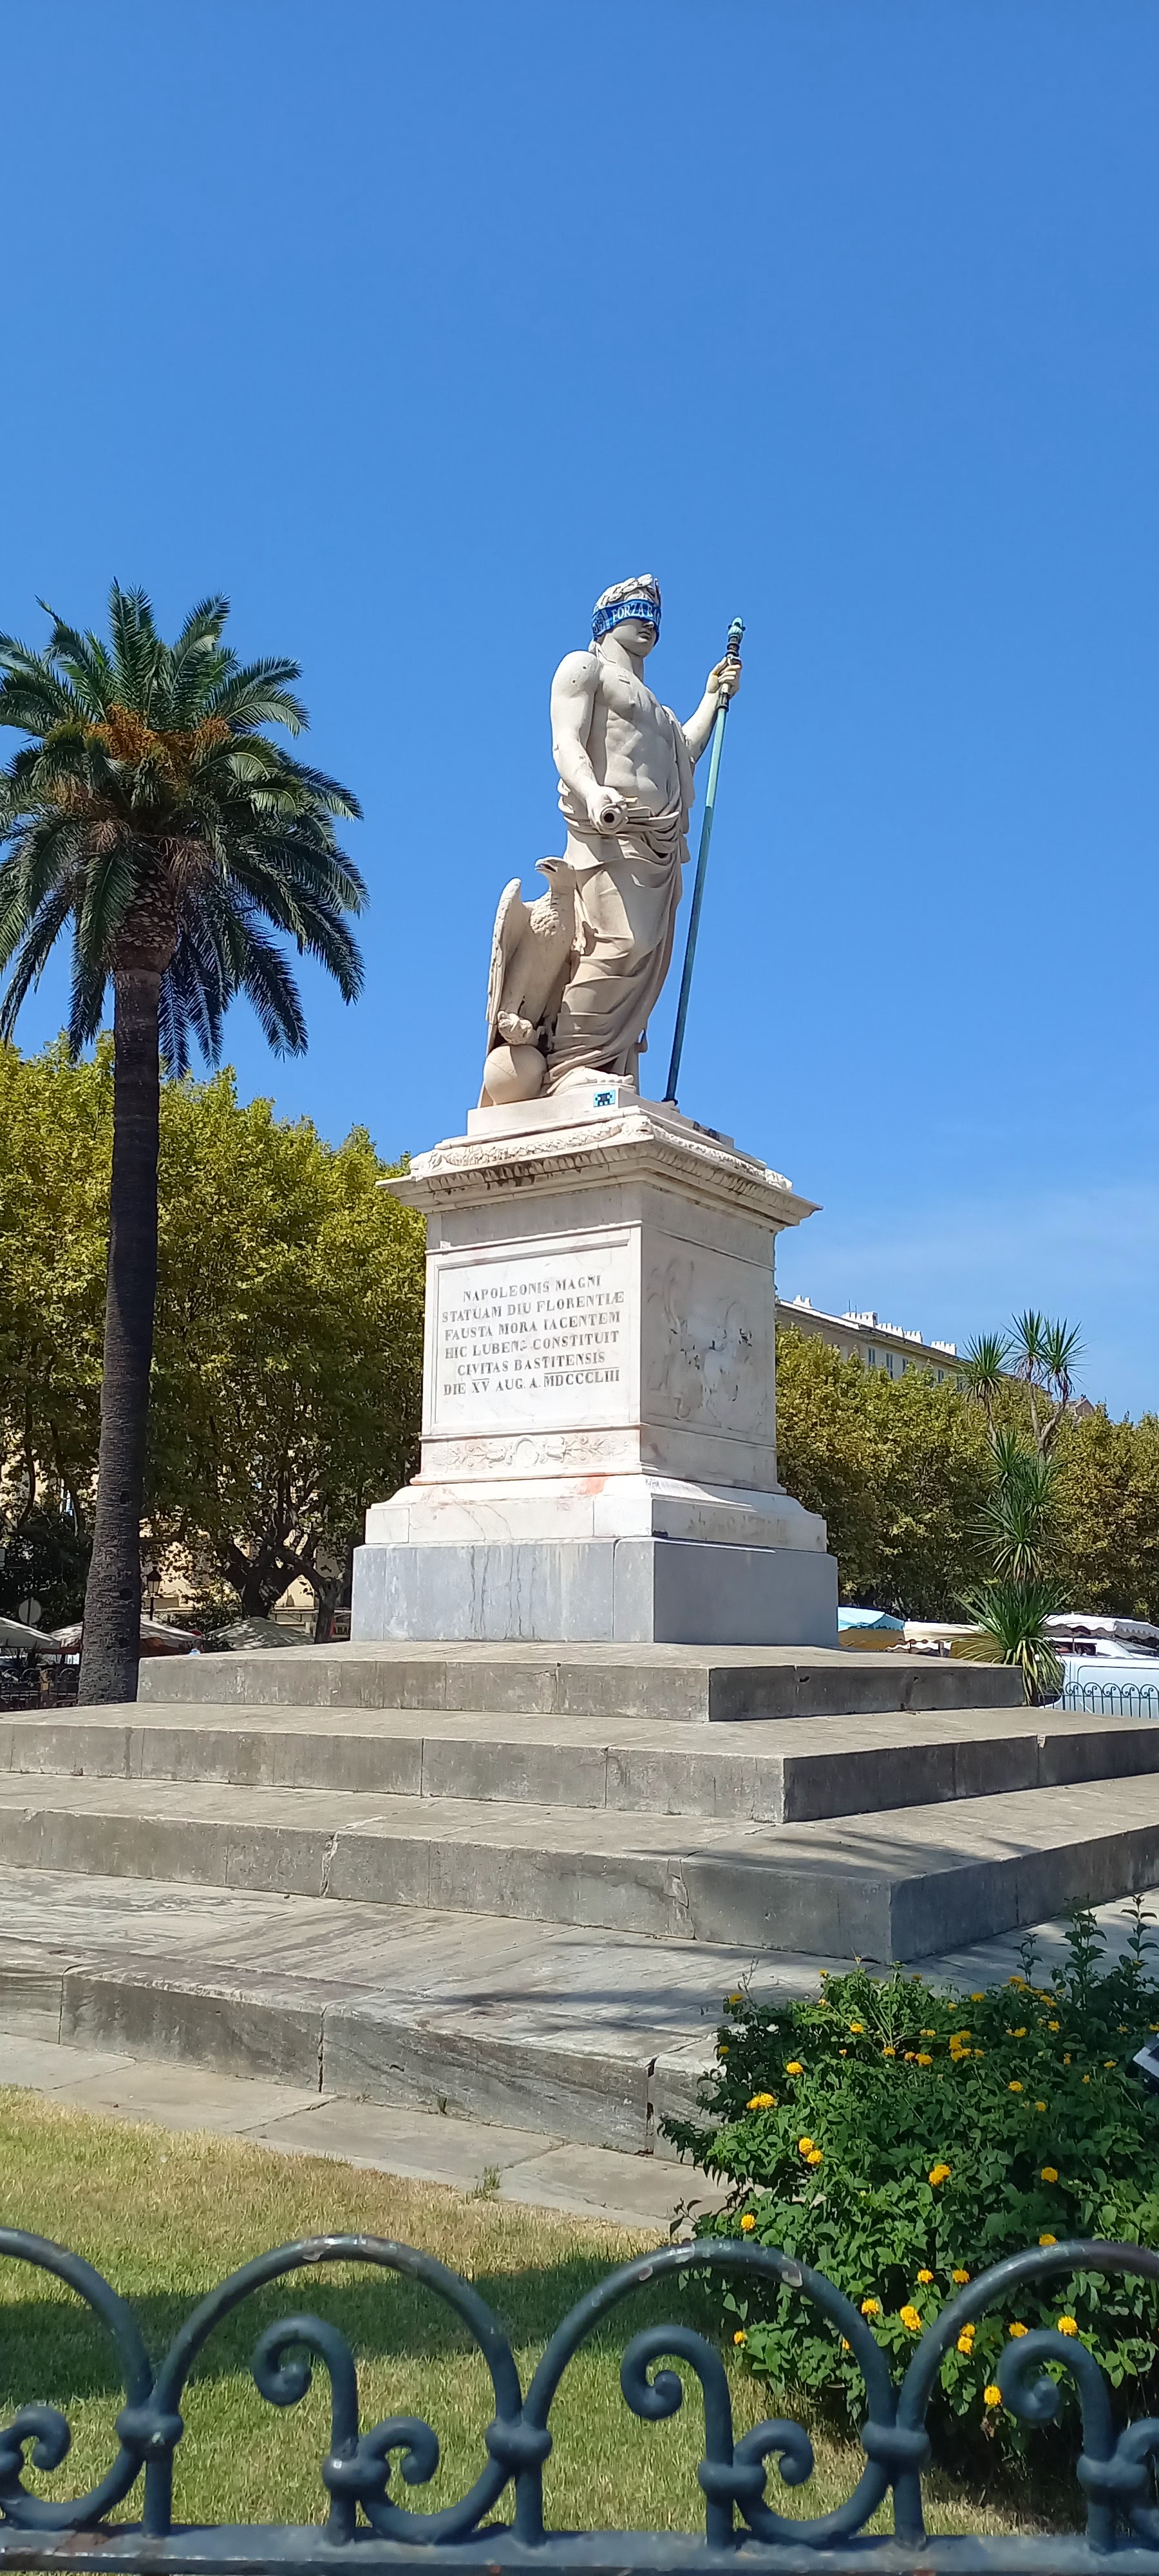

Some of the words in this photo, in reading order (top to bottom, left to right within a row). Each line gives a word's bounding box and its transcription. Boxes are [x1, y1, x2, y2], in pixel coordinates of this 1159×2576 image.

[611, 603, 645, 623] FORZA
[463, 1281, 549, 1302] NAPOLEONIS
[556, 1274, 601, 1291] MAGNI
[442, 1305, 502, 1322] STATUAM
[507, 1302, 531, 1316] DIU
[537, 1291, 624, 1312] FLORENTIÆ
[445, 1325, 493, 1341] FAUSTA
[498, 1321, 538, 1335] MORA
[543, 1311, 620, 1331] IACENTEM
[445, 1346, 467, 1359] HIC
[533, 1331, 619, 1350] CONSTITUIT
[457, 1360, 509, 1376] CIVITAS
[514, 1352, 605, 1371] BASTITENSIS
[444, 1383, 466, 1396] DIE
[472, 1378, 490, 1393] XV
[496, 1378, 526, 1392] AUG.
[544, 1367, 619, 1387] MDCCCLIII
